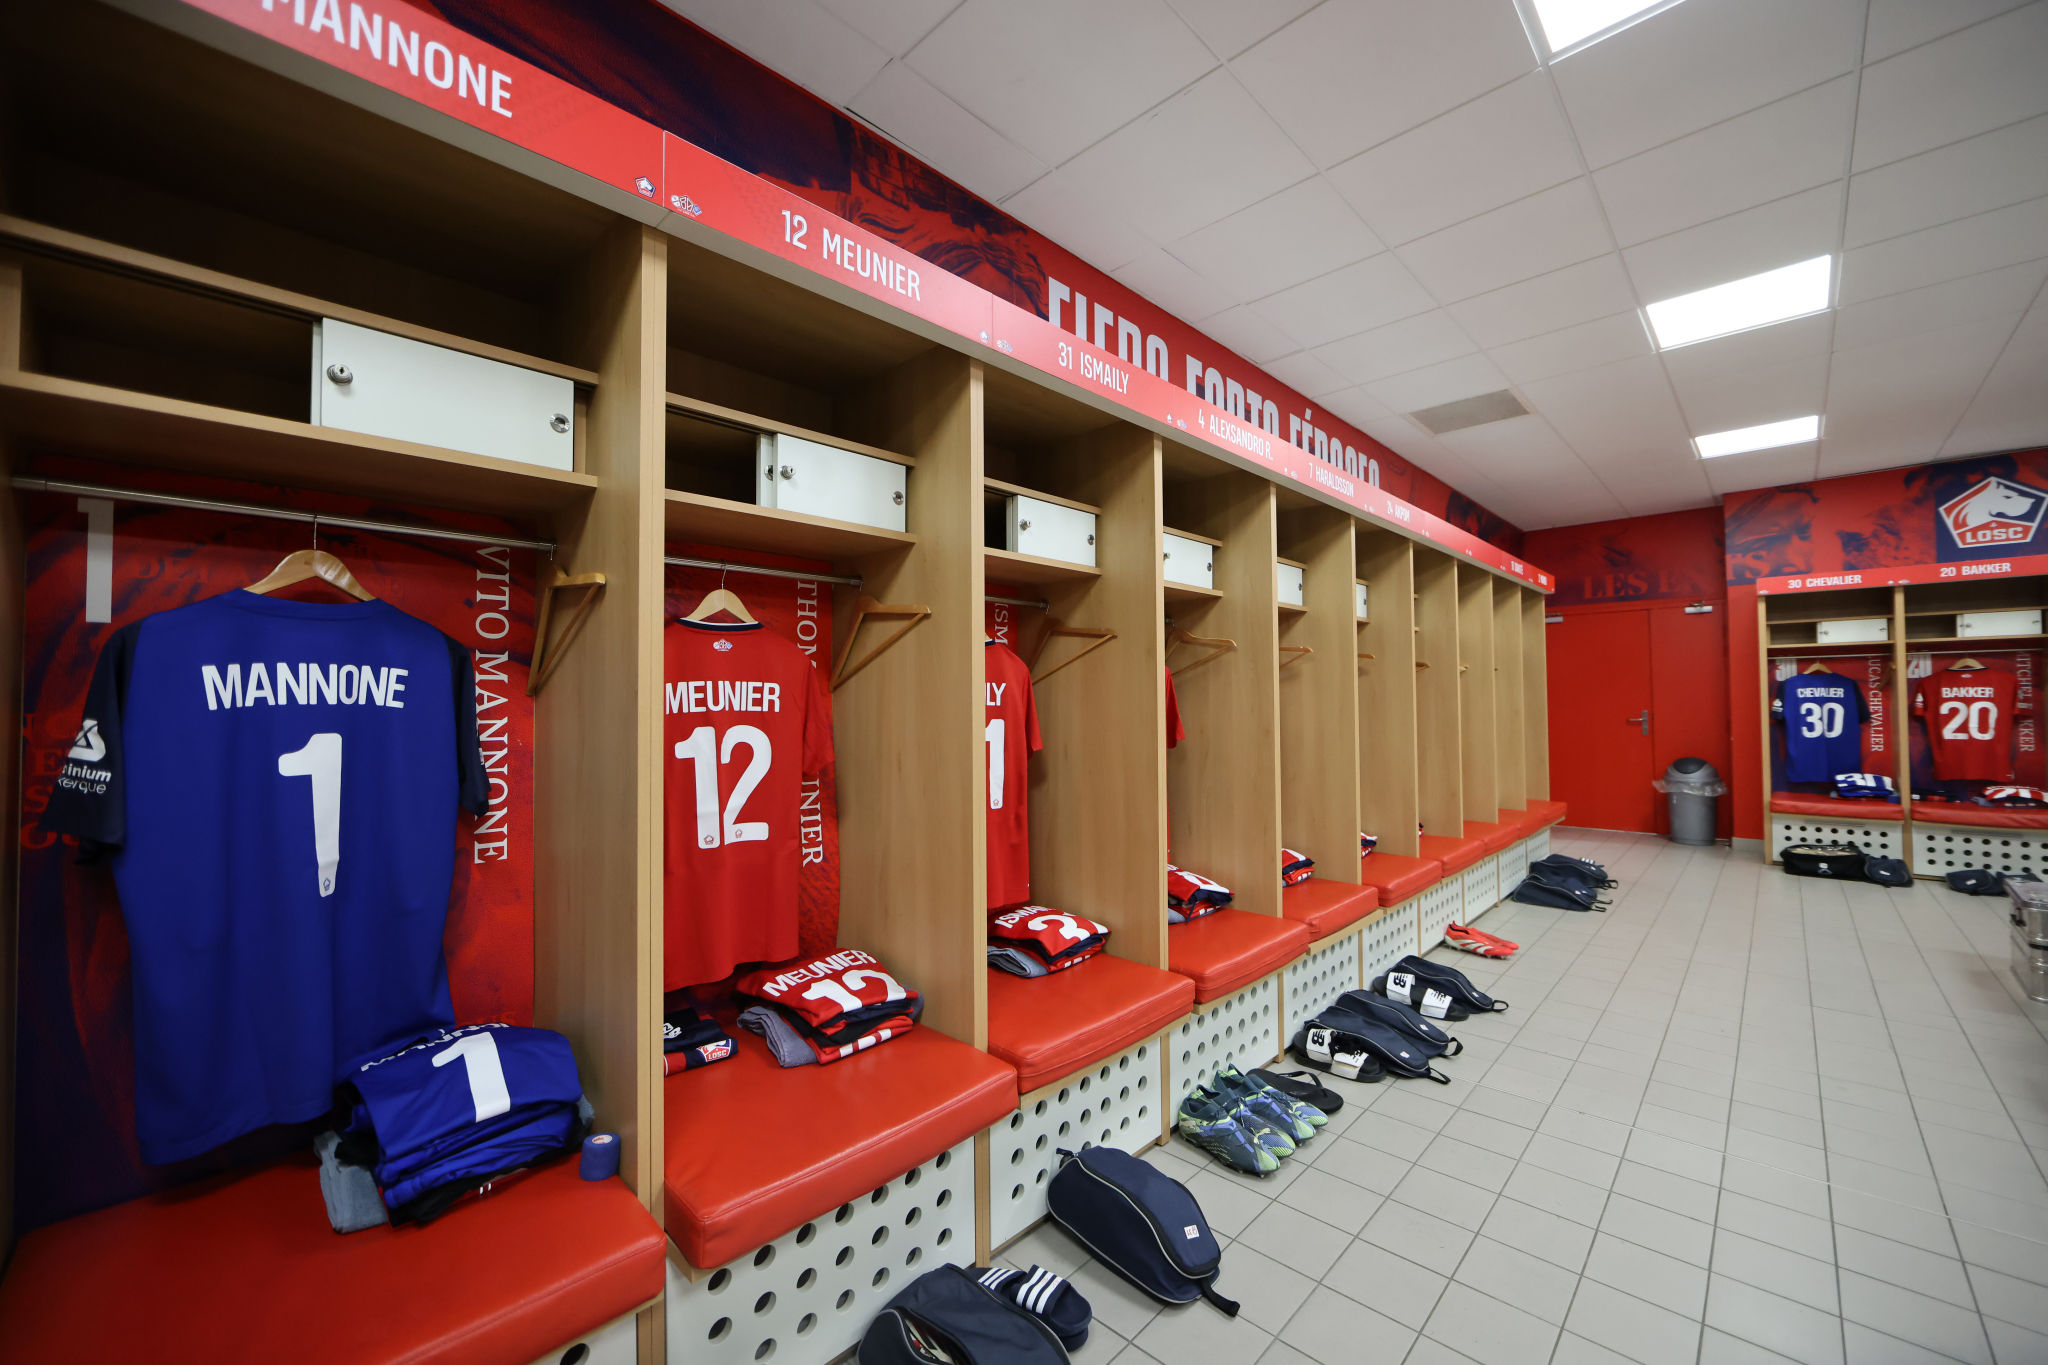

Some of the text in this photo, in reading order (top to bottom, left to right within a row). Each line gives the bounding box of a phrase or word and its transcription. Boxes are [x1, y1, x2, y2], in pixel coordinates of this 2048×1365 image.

[781, 209, 921, 302] 12 MEUNIER
[1058, 342, 1129, 395] 31 ISMAILY
[1198, 408, 1206, 429] 4
[1209, 414, 1265, 457] ALEXSANDRO
[1965, 526, 2024, 543] LOSC
[1788, 575, 1862, 589] 30 CHEVALIER
[1940, 563, 2012, 577] 20 BAKKER
[202, 662, 409, 711] MANNONE
[475, 546, 510, 864] VITO MANNONE
[665, 680, 780, 715] MEUNIER
[985, 682, 1007, 706] LY
[1797, 687, 1845, 698] CHEVALIER
[1941, 687, 1994, 698] BAKKER
[1800, 702, 1845, 739] 30
[1940, 701, 1998, 740] 20
[674, 724, 772, 850] 12
[278, 733, 343, 898] 1
[762, 950, 877, 997] MEUNIER
[708, 1049, 727, 1060] LOSC
[431, 1031, 511, 1123] 1
